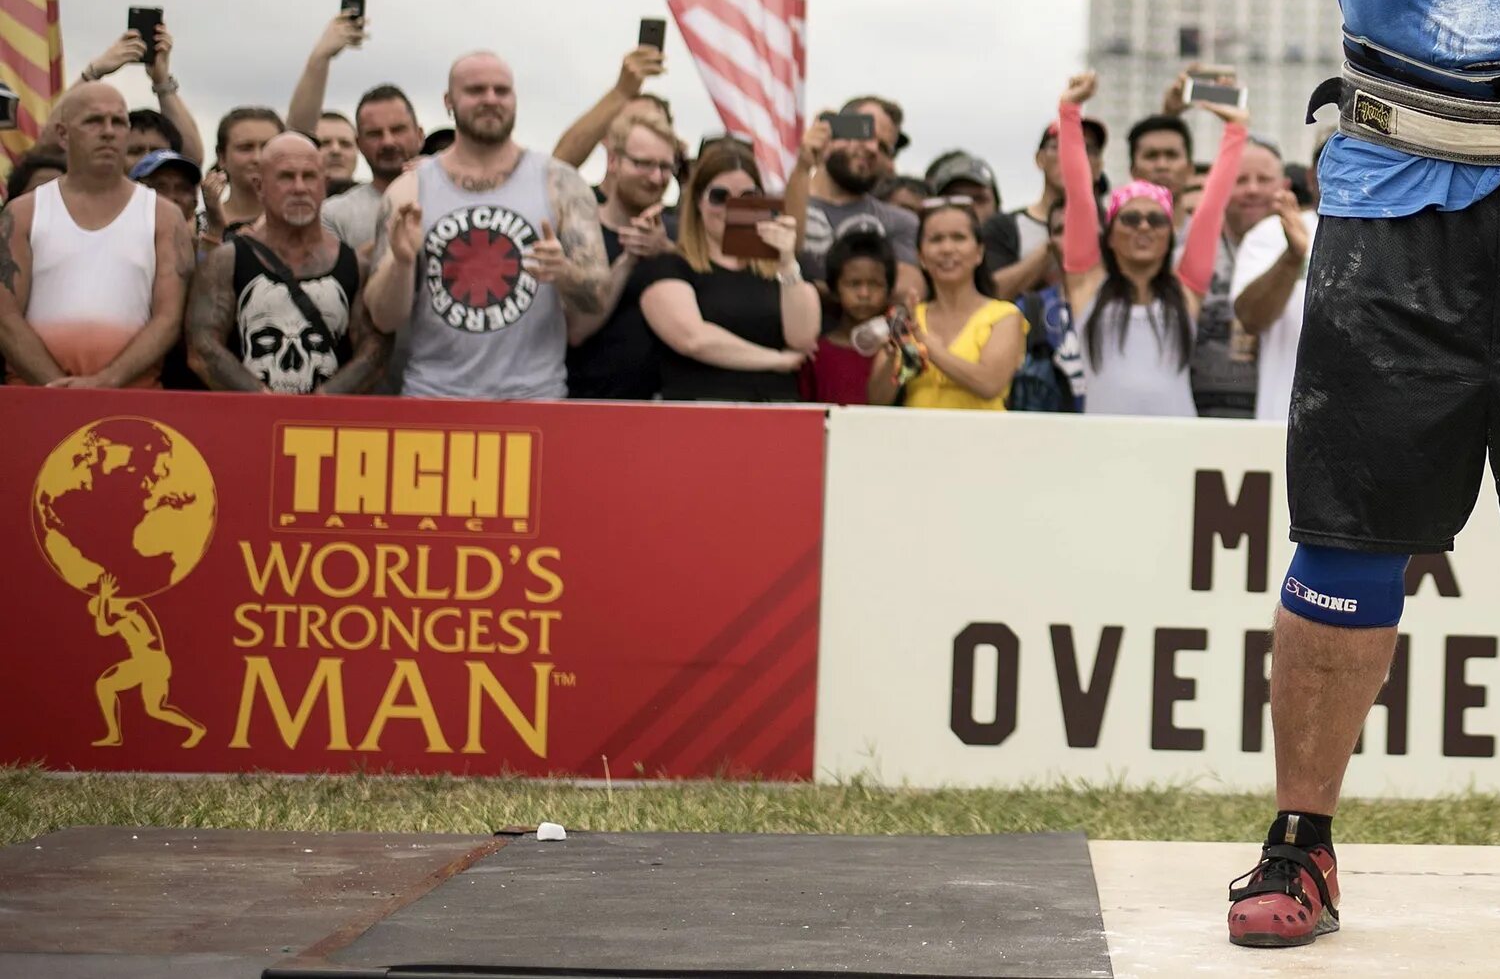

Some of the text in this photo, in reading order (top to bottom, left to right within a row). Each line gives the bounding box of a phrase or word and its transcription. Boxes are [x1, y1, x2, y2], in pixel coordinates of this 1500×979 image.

[425, 208, 469, 258] HOT
[283, 426, 532, 518] TACHI
[280, 513, 528, 533] PALACE
[238, 541, 564, 603] WORLD'S
[1286, 576, 1358, 612] STRONG
[233, 603, 562, 655] STRONGEST
[228, 655, 556, 759] MAN
